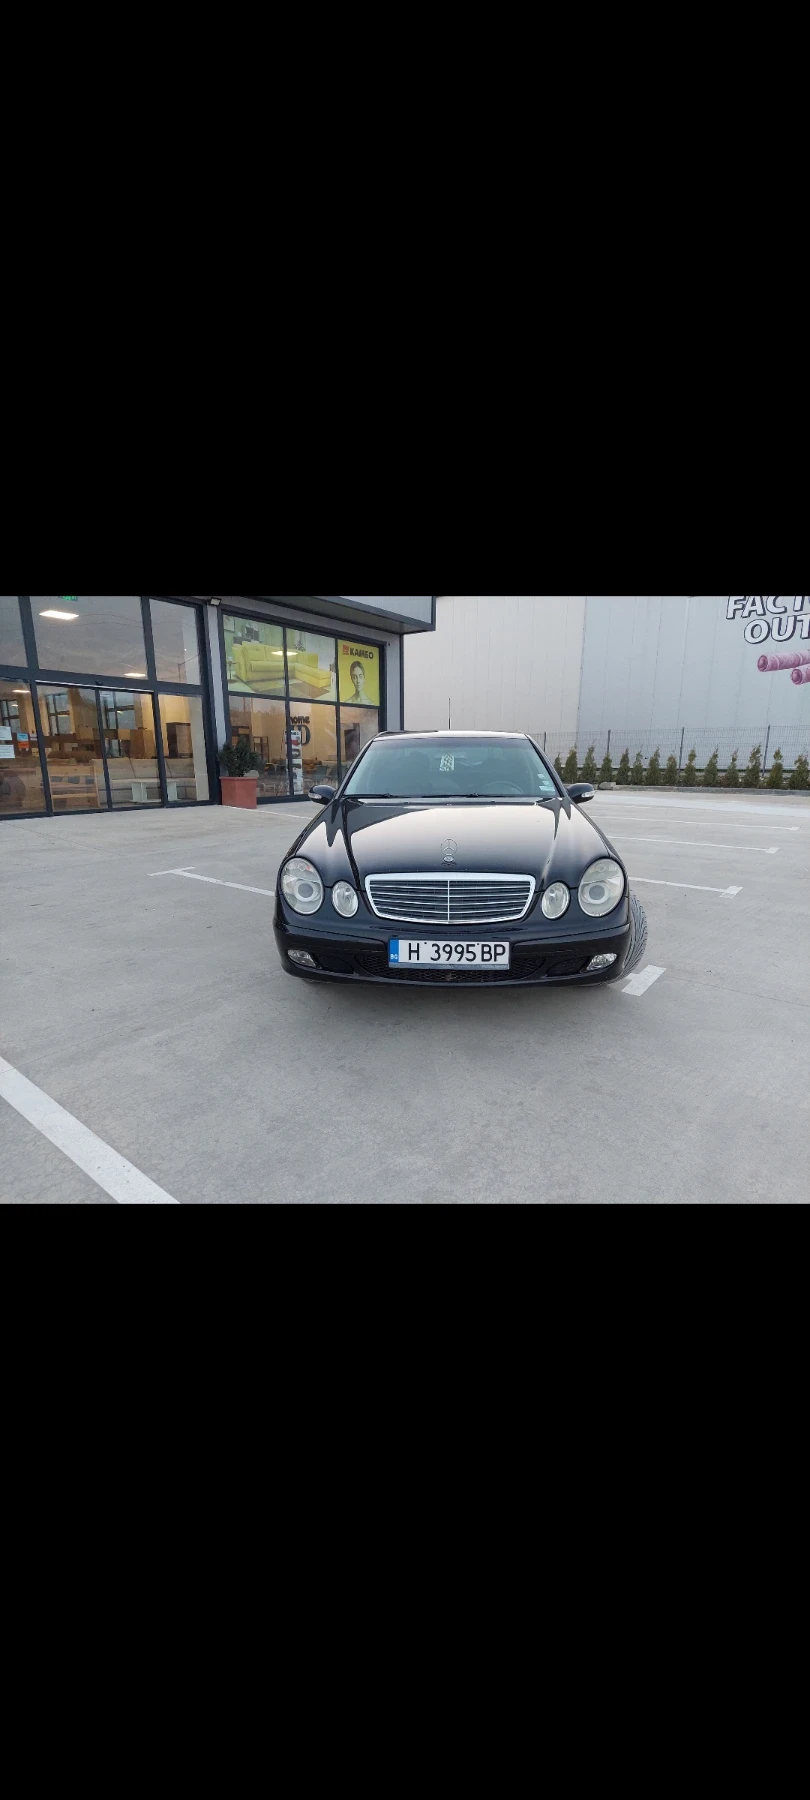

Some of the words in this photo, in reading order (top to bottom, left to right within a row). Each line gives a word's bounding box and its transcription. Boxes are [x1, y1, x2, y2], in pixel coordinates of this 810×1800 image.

[726, 596, 810, 619] FACT
[744, 613, 810, 644] OUT
[430, 943, 477, 962] 3995
